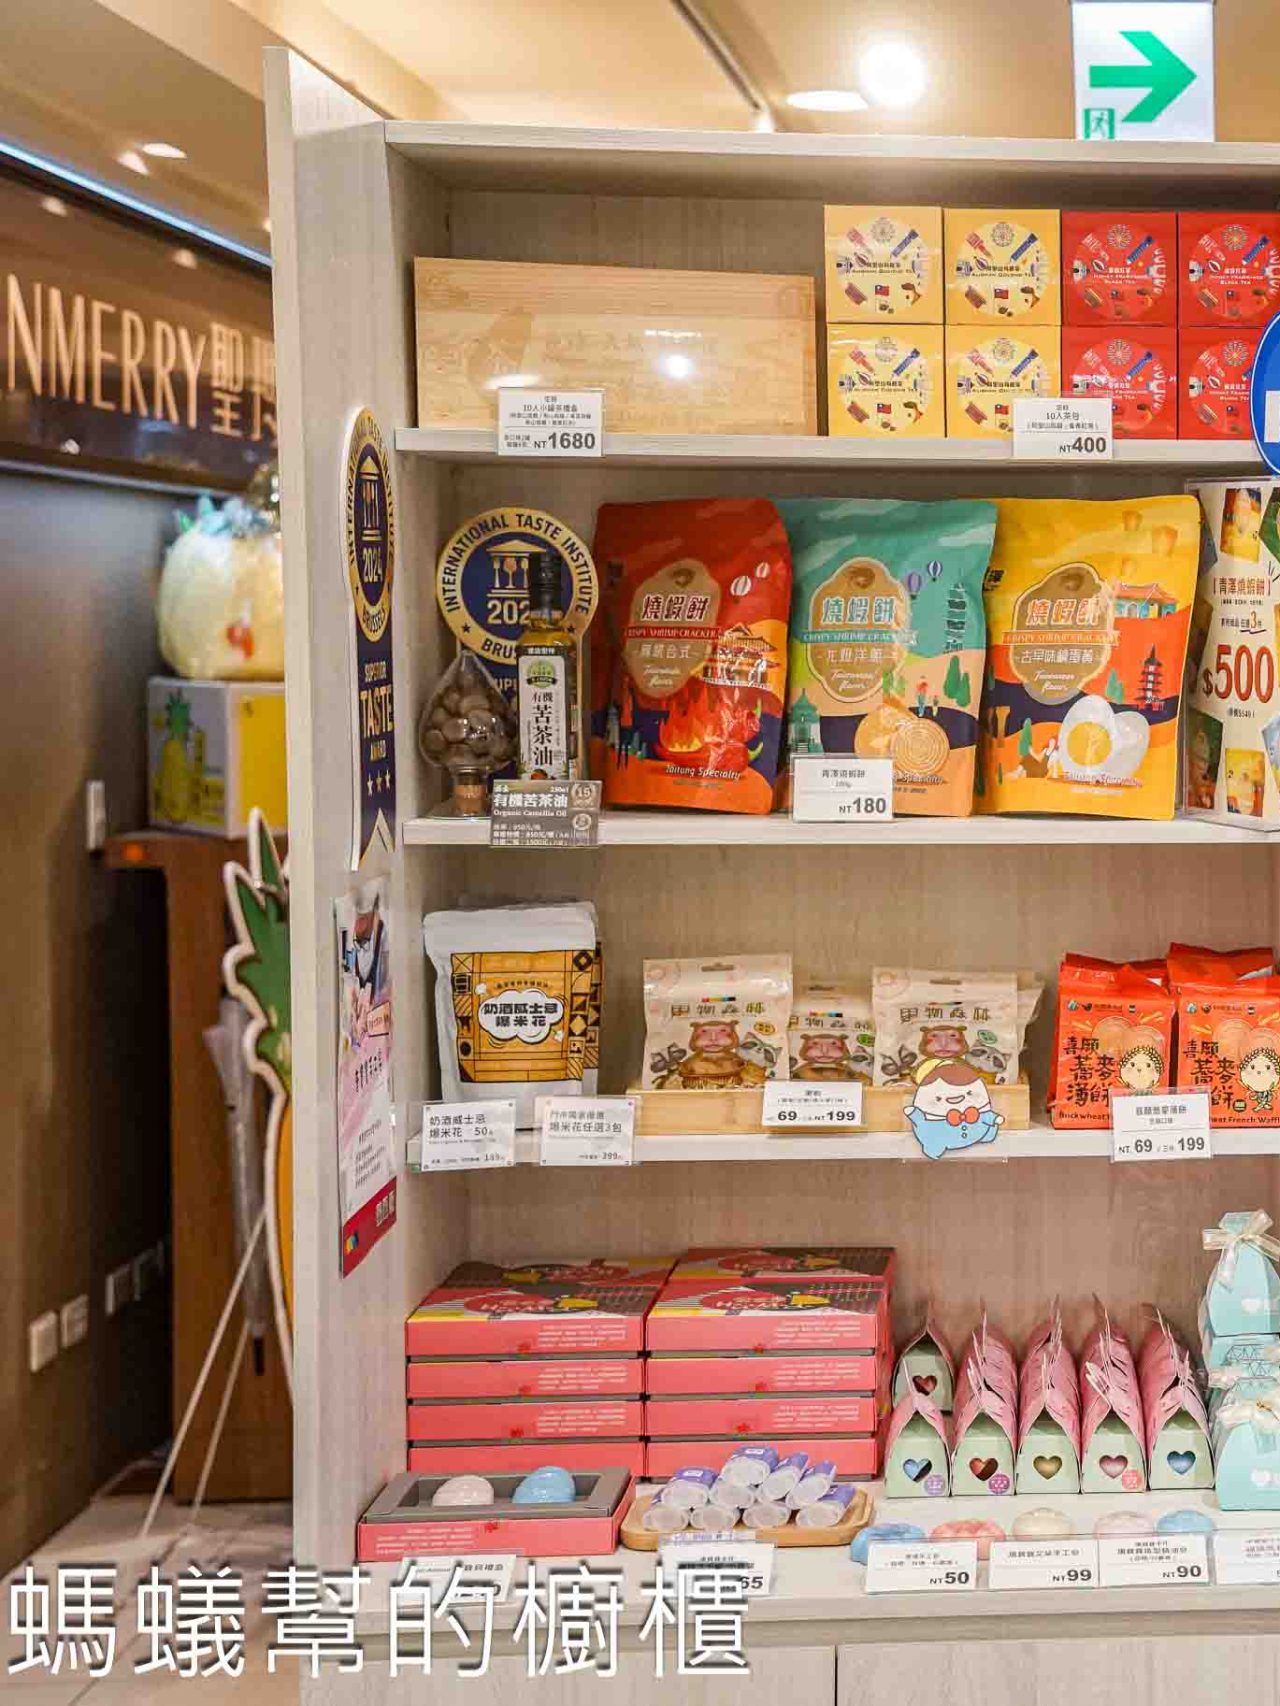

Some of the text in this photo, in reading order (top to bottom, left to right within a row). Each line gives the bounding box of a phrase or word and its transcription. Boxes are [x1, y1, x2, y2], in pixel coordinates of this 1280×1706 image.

[362, 547, 384, 583] 2024
[442, 514, 593, 615] INTERNATIONAL TASTE INSTITUTE
[487, 600, 530, 624] 202
[642, 594, 709, 621] 燒蝦餅
[821, 596, 898, 625] 燒蝦餅
[1202, 643, 1275, 704] $500
[531, 692, 553, 703] 有機
[360, 683, 394, 738] TASTE
[532, 704, 553, 766] 苦茶油
[698, 767, 741, 781] Specialty
[493, 793, 568, 808] 有機苦茶油
[483, 1003, 558, 1015] 奶酒威士忌
[495, 1016, 546, 1027] 爆米花
[1064, 1036, 1099, 1056] 喜願
[1184, 1040, 1219, 1060] 喜願
[1070, 1056, 1116, 1081] 蕎麥
[1190, 1060, 1236, 1084] 蕎麥
[1066, 1083, 1110, 1107] 薄餅
[1210, 1086, 1235, 1109] 餅
[429, 1113, 486, 1126] 奶酒威士忌
[777, 1111, 797, 1121] 69
[1228, 1115, 1256, 1124] French
[429, 1127, 463, 1139] 爆米花
[1134, 1139, 1153, 1153] 69
[1177, 1136, 1205, 1151] 199
[929, 1571, 969, 1585] NT50
[1052, 1569, 1092, 1582] NT99
[1162, 1565, 1202, 1578] NT90
